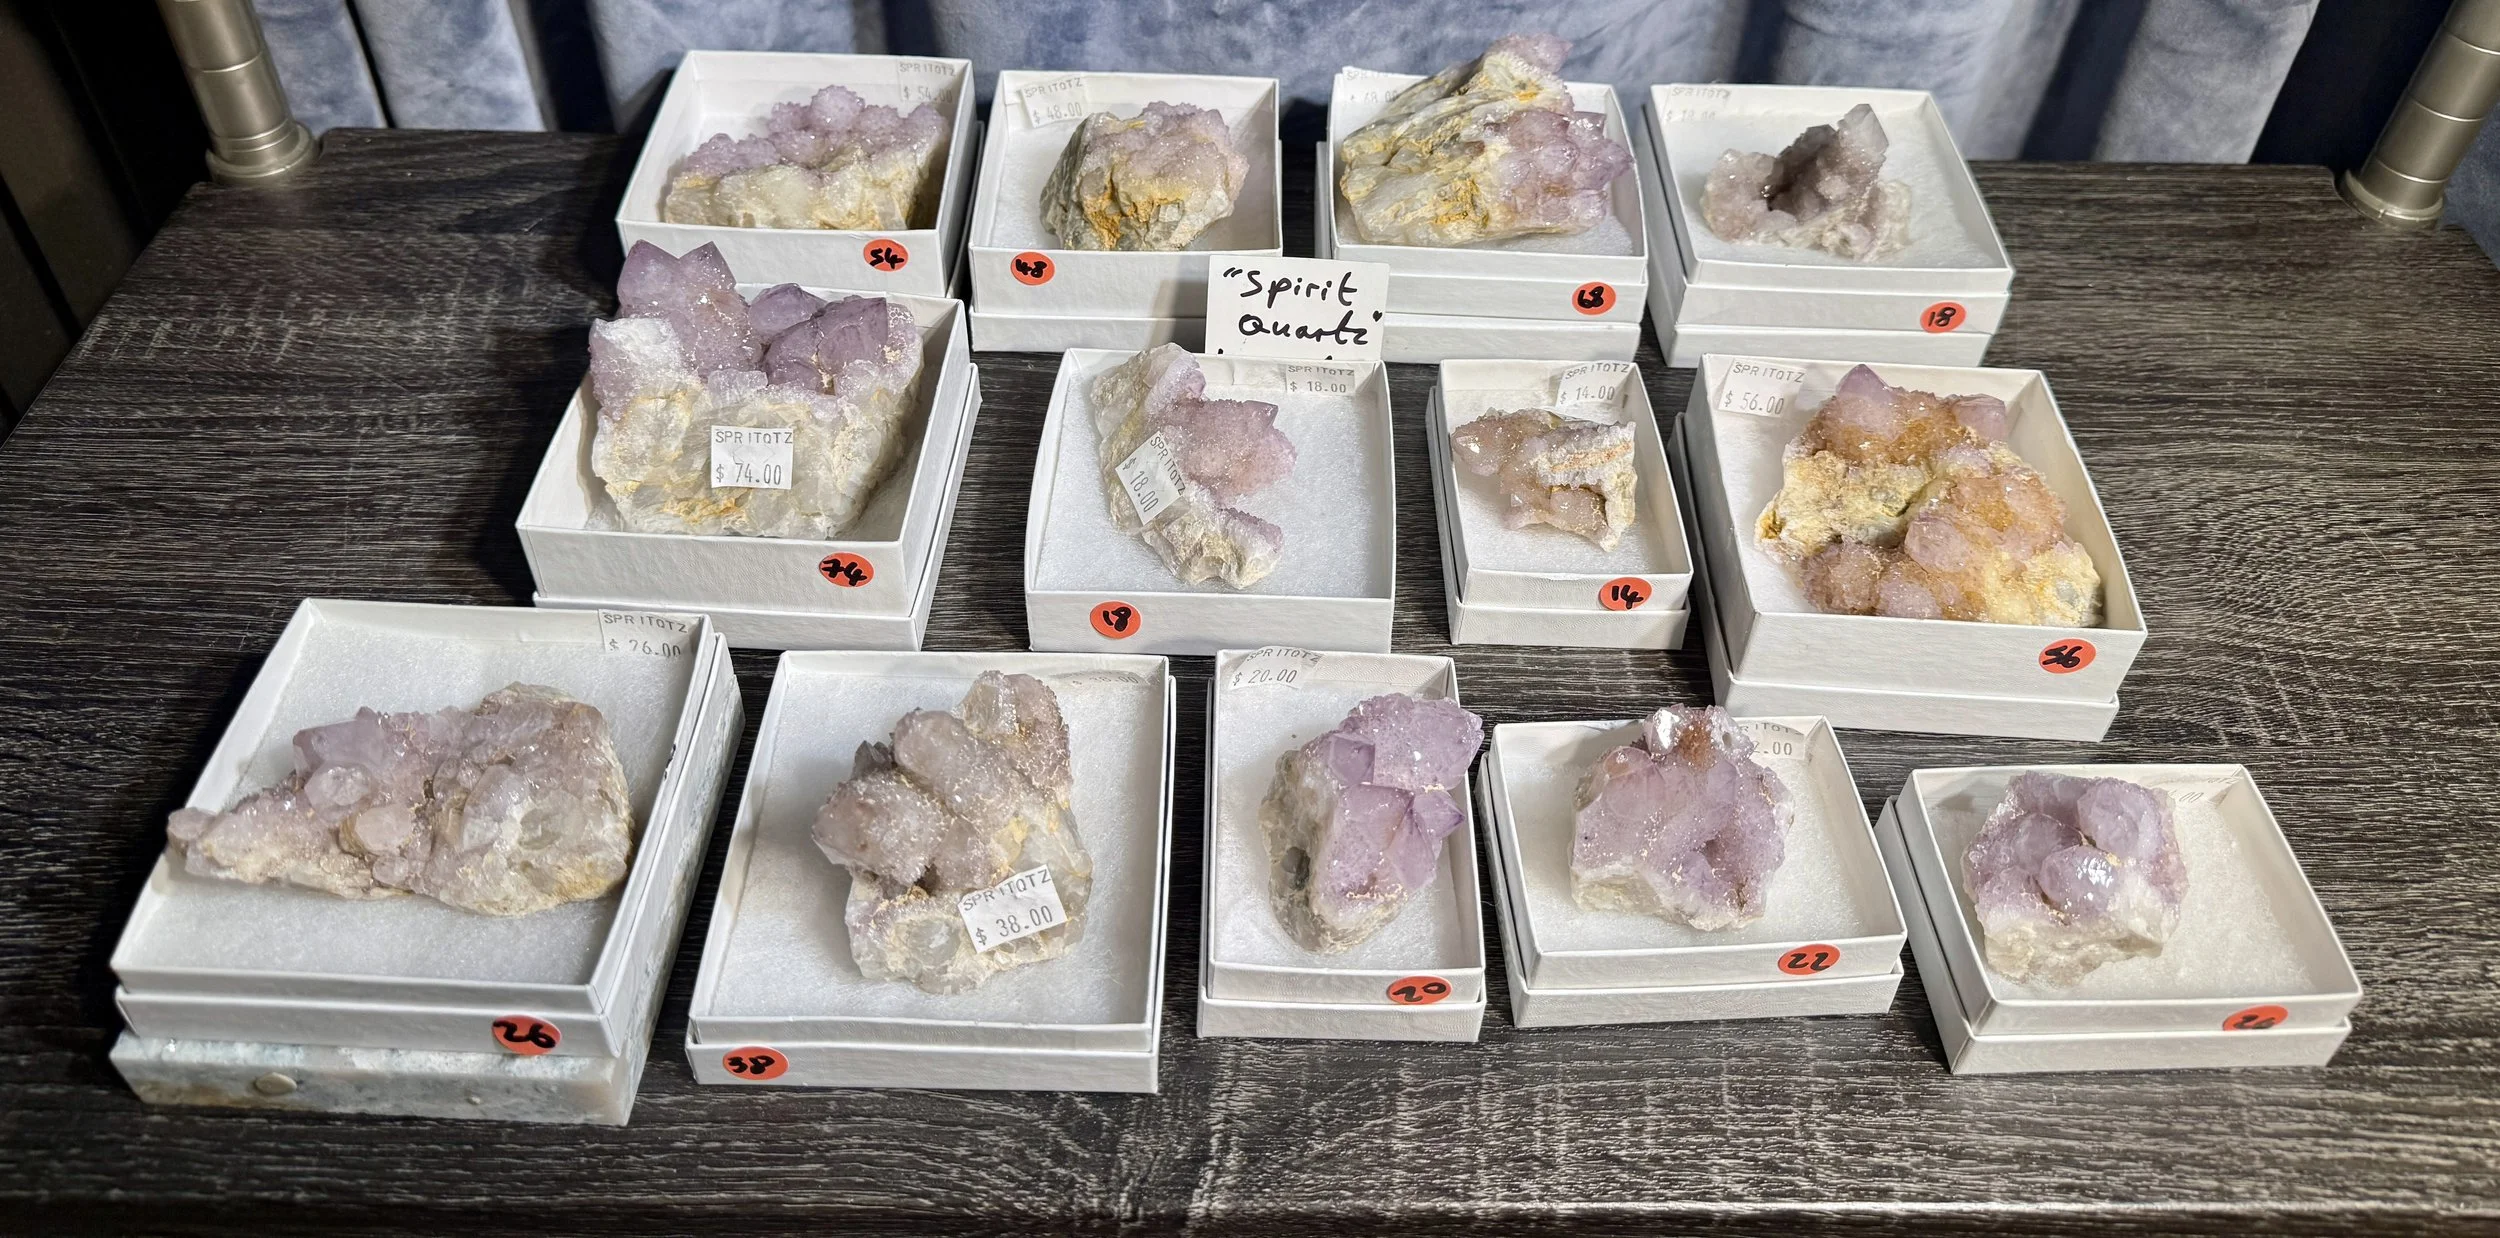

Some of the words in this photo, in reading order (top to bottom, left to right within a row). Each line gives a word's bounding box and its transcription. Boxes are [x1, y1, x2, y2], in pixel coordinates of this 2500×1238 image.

[1046, 102, 1082, 120] 48.00
[869, 247, 905, 270] 54
[1015, 258, 1048, 278] 48
[1577, 286, 1605, 309] 68
[1928, 306, 1957, 327] 18
[1307, 380, 1347, 393] 18.00
[1575, 385, 1616, 401] 14.00
[1740, 392, 1785, 415] 56.00
[735, 462, 782, 486] 74.00
[1130, 470, 1159, 513] 18.00
[822, 558, 868, 587] 74
[1612, 584, 1644, 610] 14
[1102, 606, 1132, 632] 18
[2042, 645, 2083, 668] 56
[1247, 669, 1298, 684] 20.00
[995, 905, 1054, 937] 38.00
[1787, 952, 1832, 972] 22
[1392, 982, 1447, 1002] 20
[493, 1020, 557, 1049] 26
[727, 1055, 776, 1075] 38
